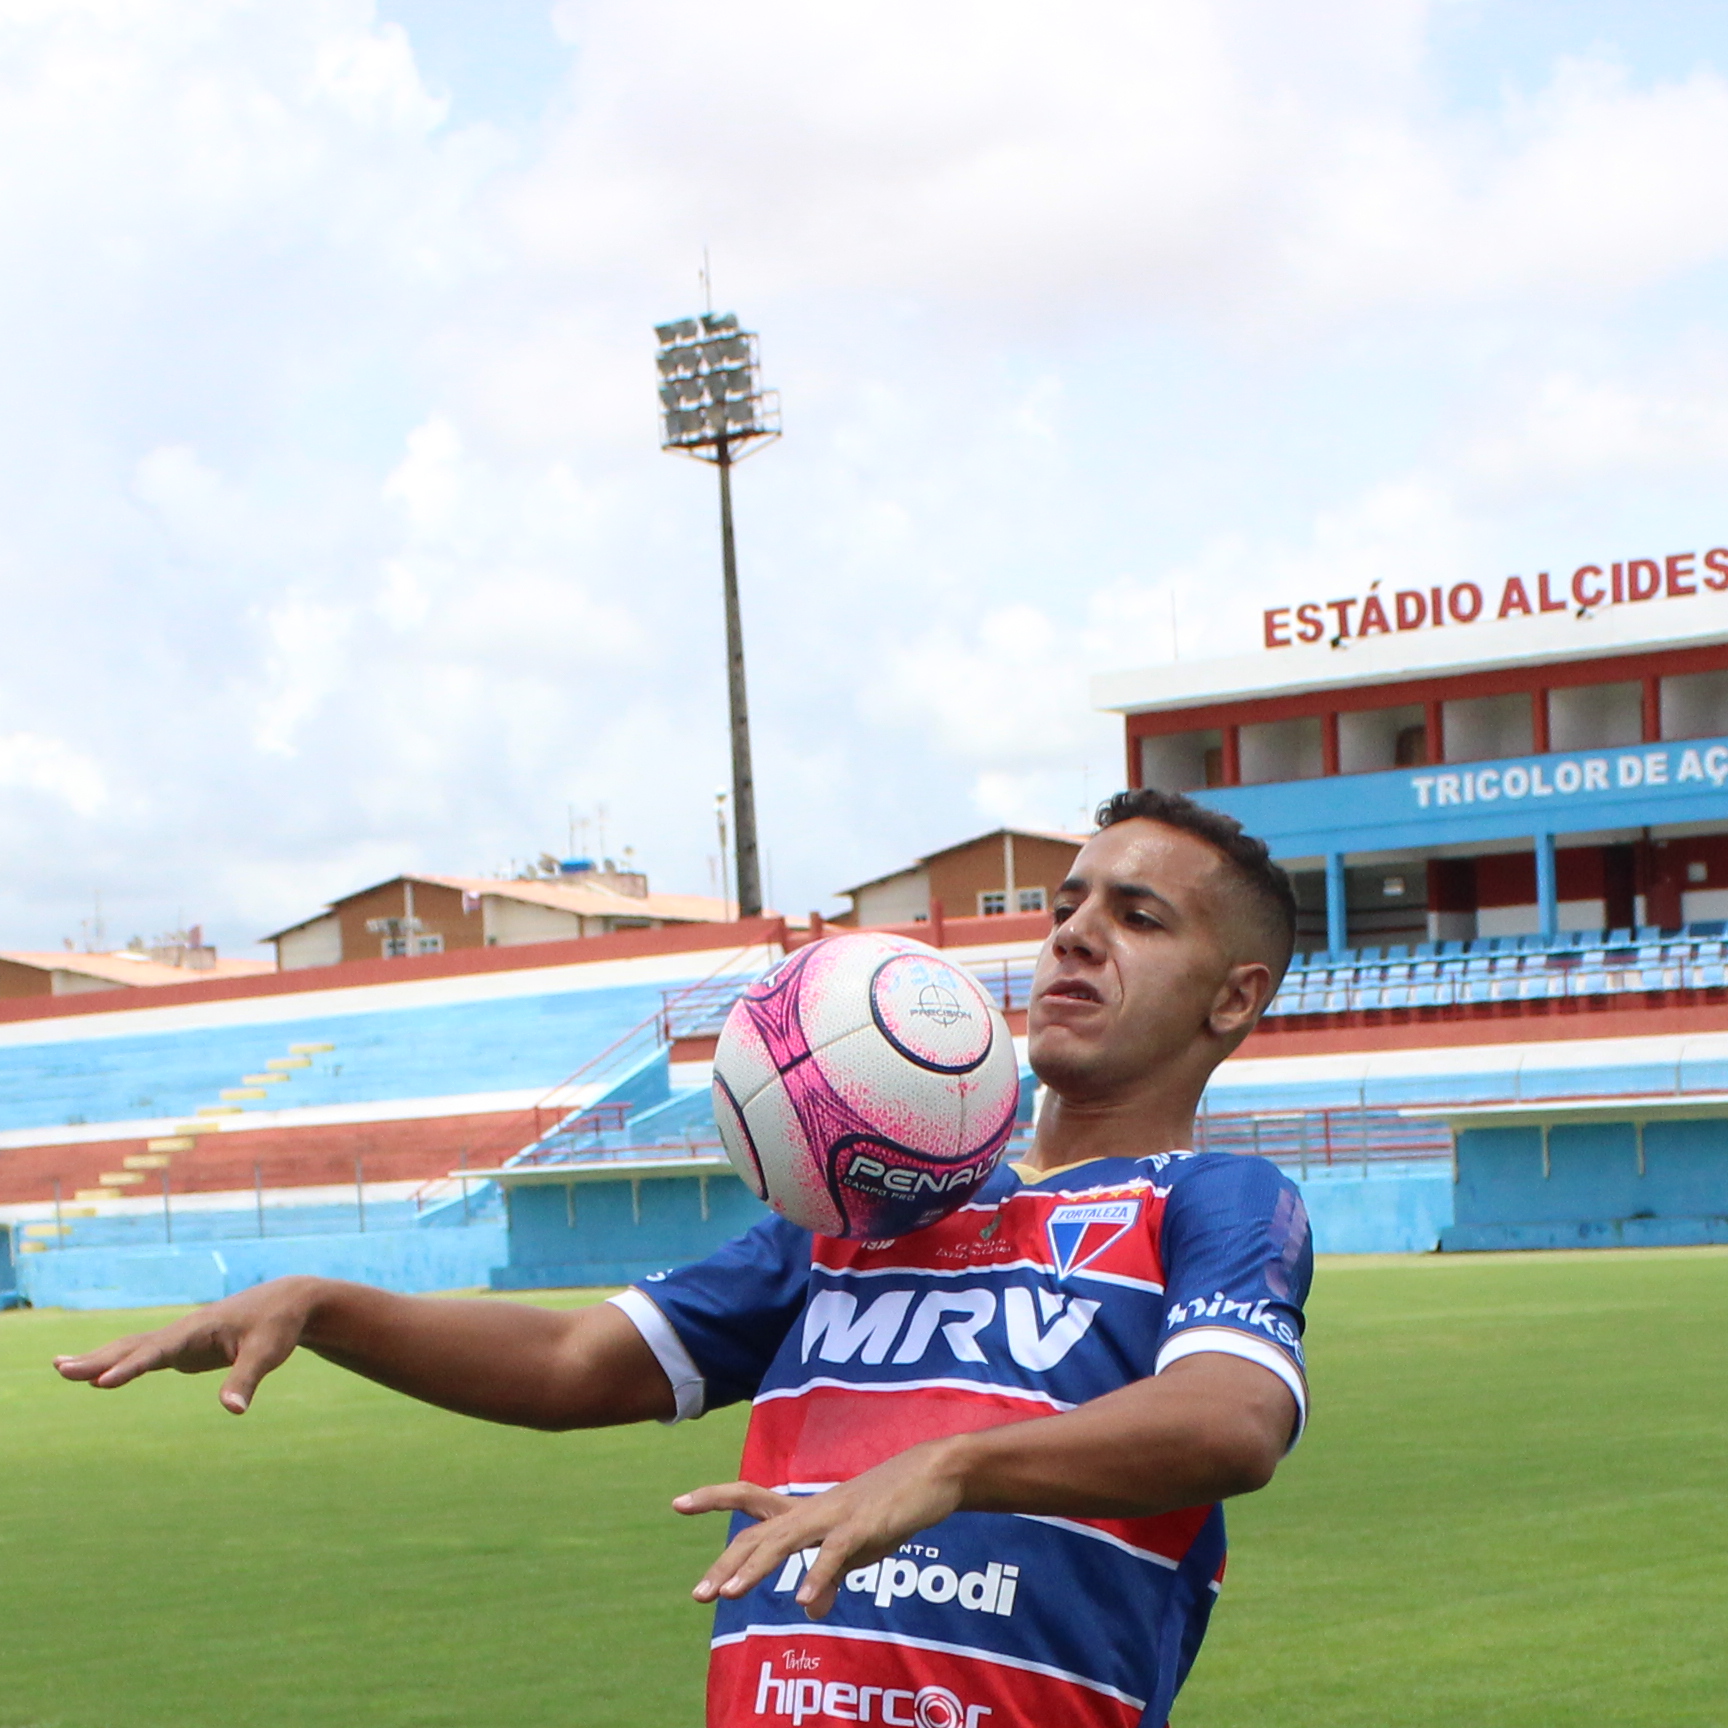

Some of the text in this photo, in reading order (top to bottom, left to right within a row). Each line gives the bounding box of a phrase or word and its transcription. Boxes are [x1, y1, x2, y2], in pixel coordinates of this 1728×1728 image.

[1263, 579, 1484, 650] ESTÁDIO
[1410, 758, 1610, 808] TRICOLOR
[1617, 752, 1670, 788] DE
[909, 1008, 972, 1021] PRECISION
[843, 1177, 917, 1202] CAMPO PRO
[1057, 1206, 1129, 1220] FORTALEZA
[802, 1286, 1103, 1374] MRV
[781, 1649, 821, 1671] Tintas
